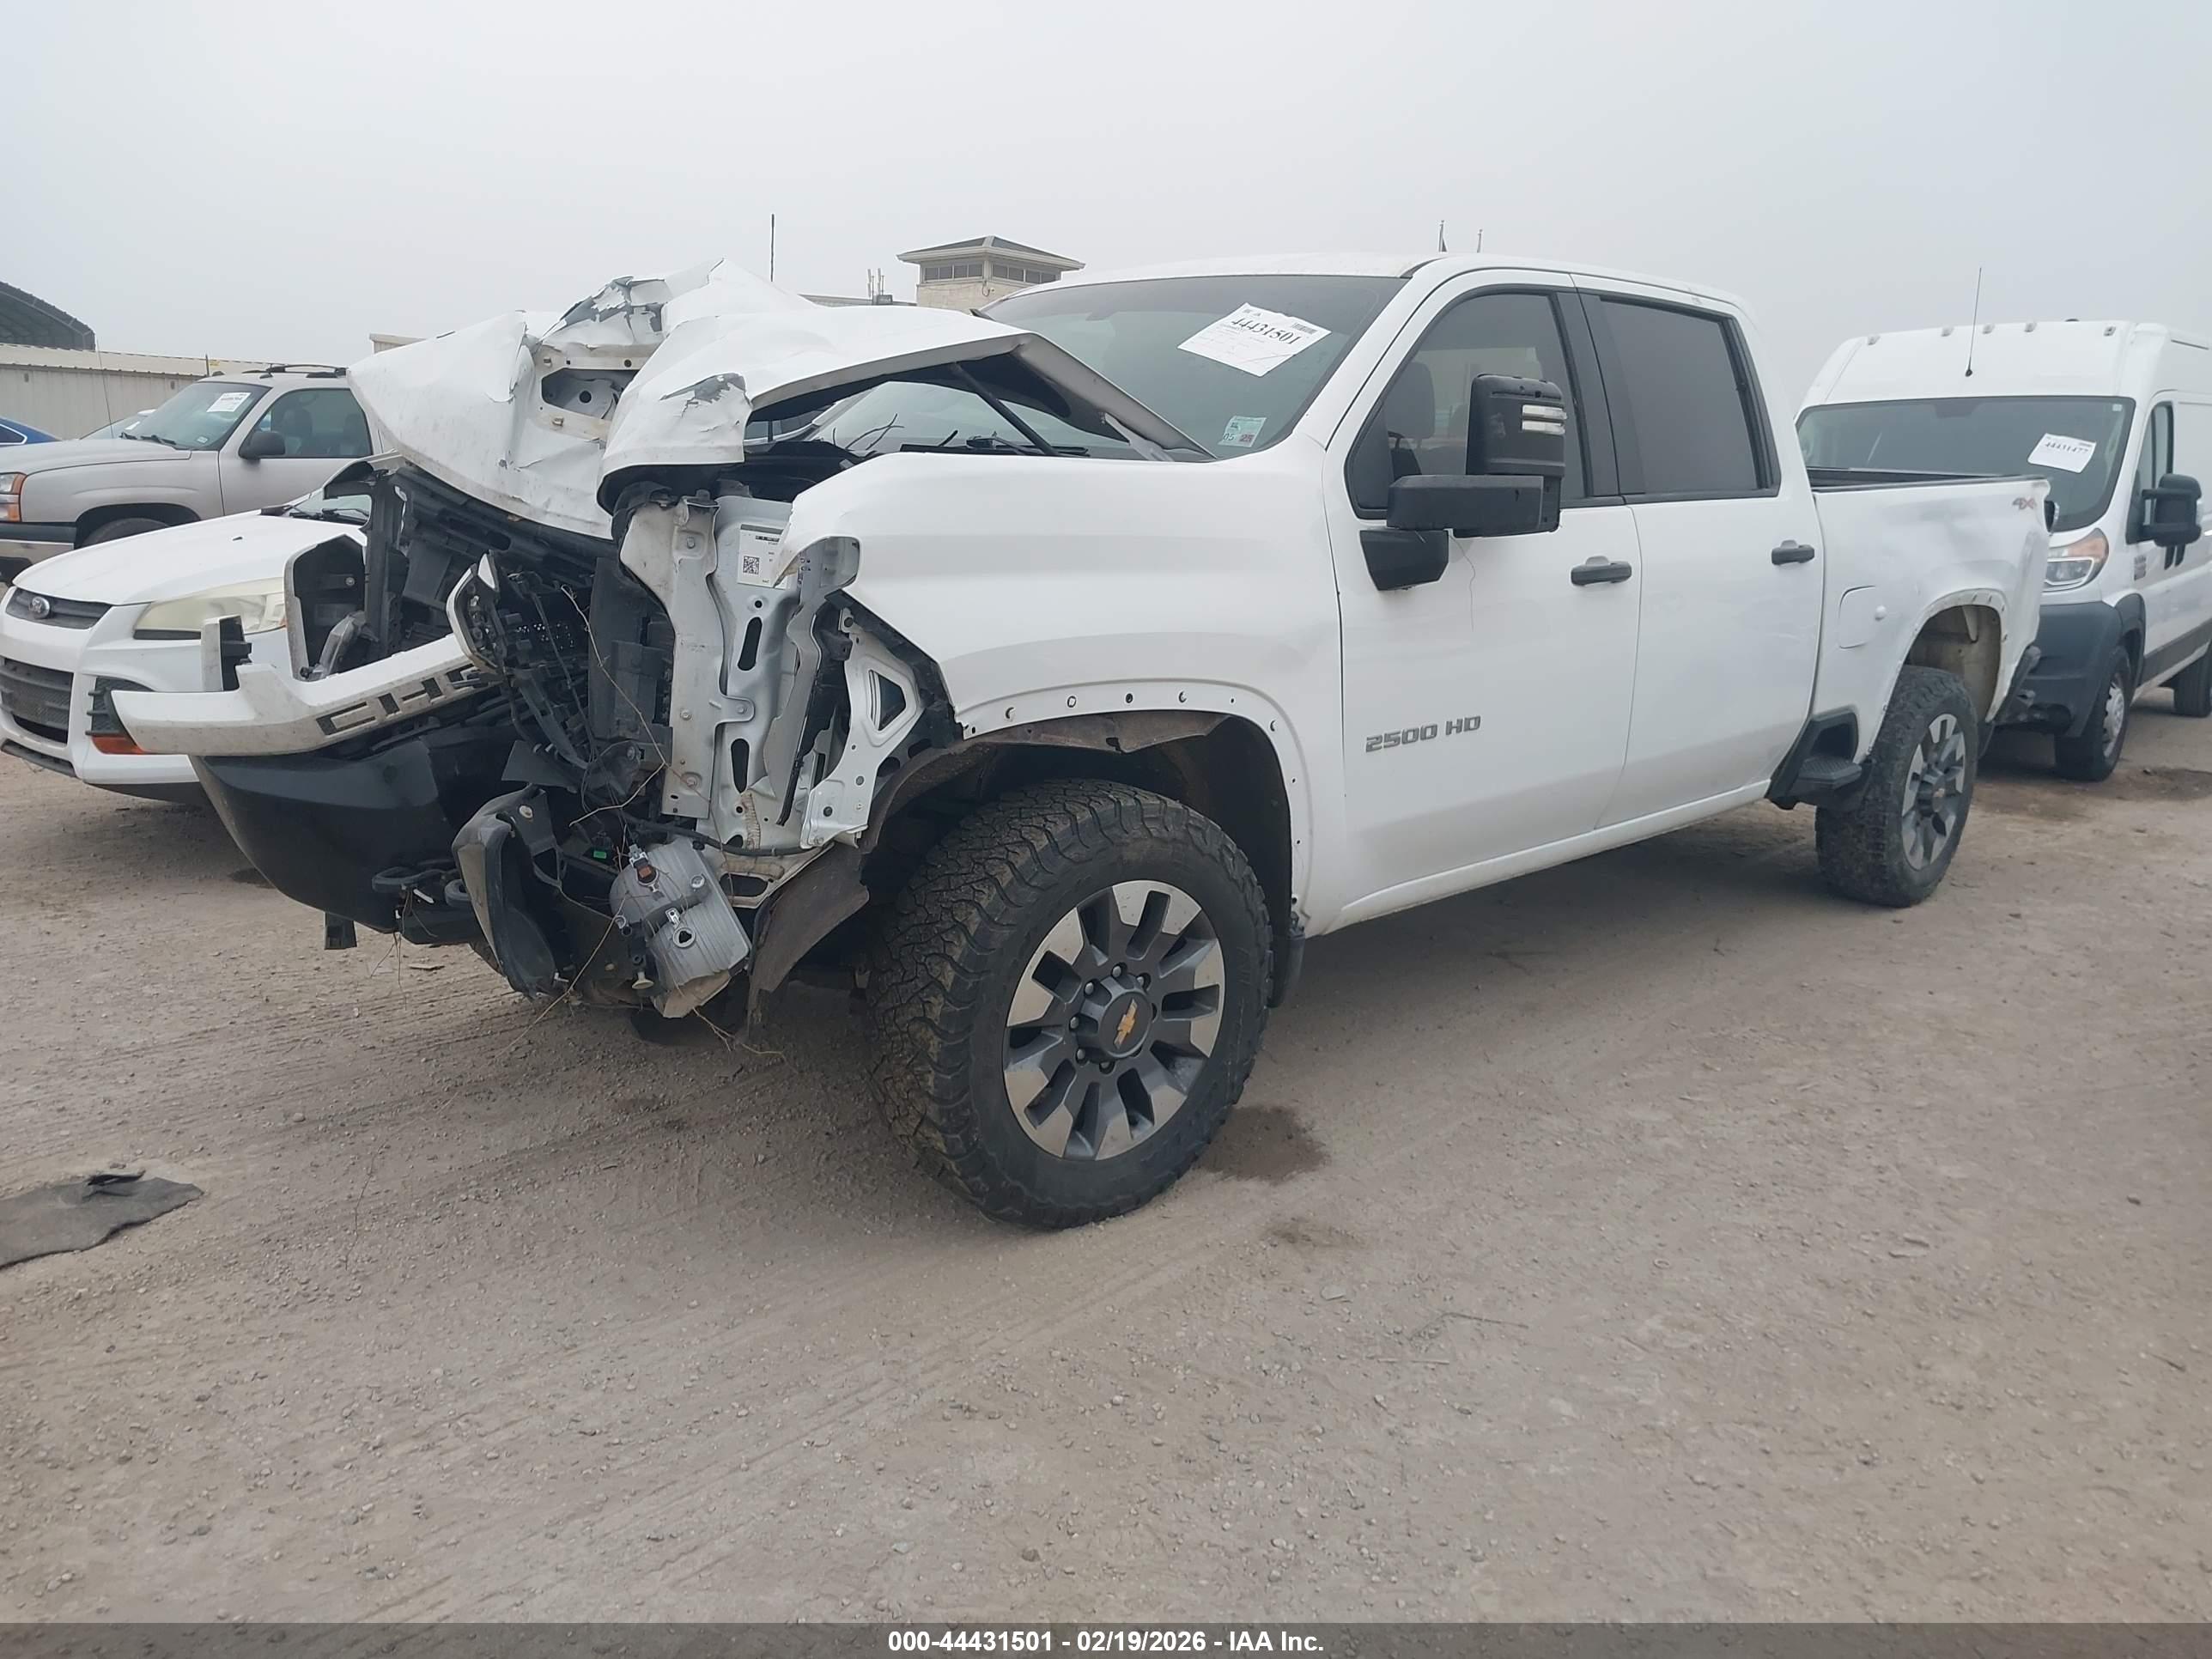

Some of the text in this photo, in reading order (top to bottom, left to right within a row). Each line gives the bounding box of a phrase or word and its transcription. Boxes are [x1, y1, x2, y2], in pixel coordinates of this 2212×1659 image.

[1231, 317, 1301, 344] 44431501
[1365, 714, 1482, 753] 2500 HD
